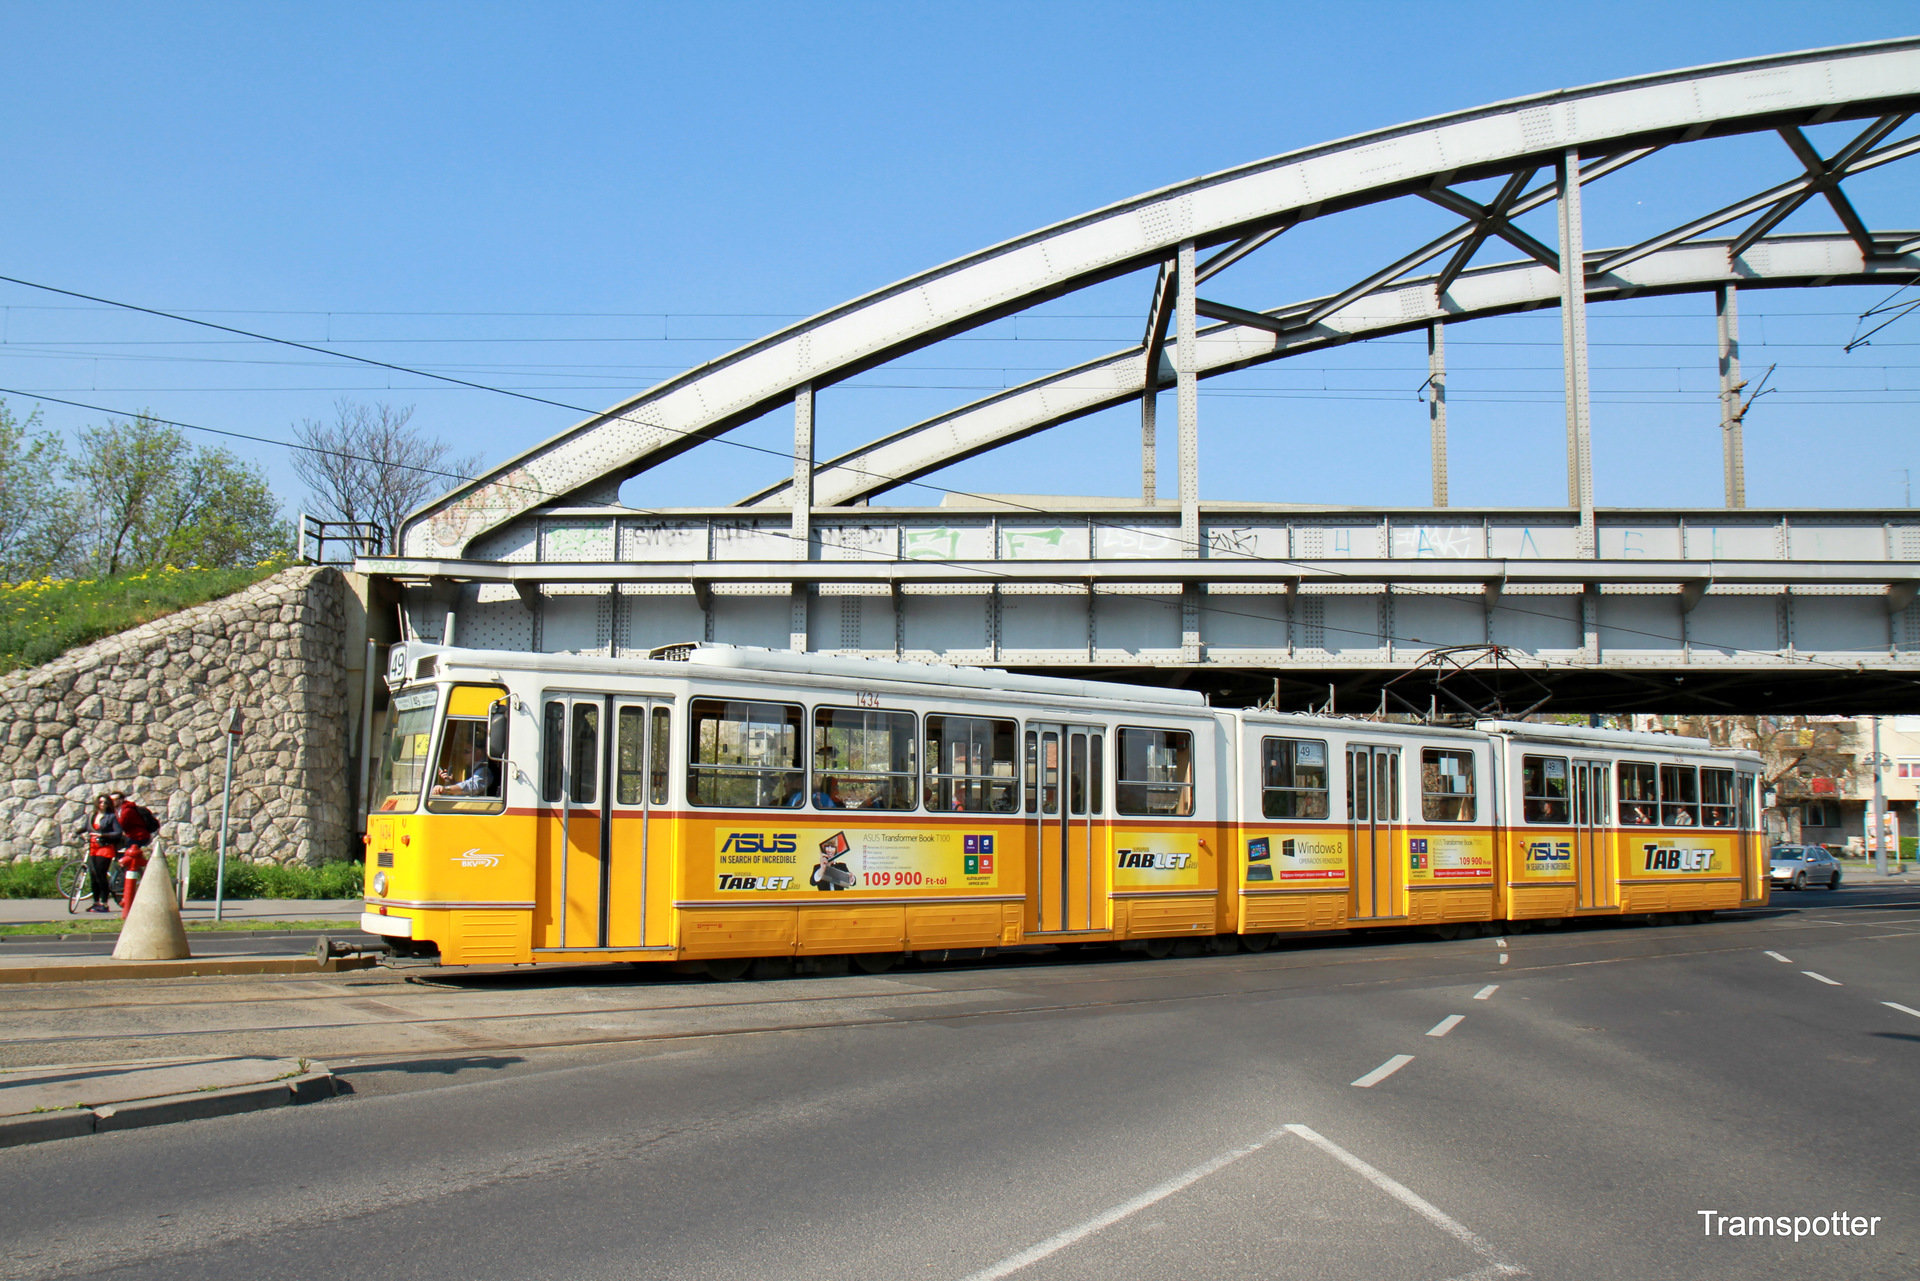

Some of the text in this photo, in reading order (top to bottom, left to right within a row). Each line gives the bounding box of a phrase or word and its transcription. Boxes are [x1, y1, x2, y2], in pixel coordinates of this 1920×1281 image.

[392, 653, 405, 677] 49
[856, 689, 880, 709] 1434
[1300, 746, 1310, 757] 49
[721, 833, 797, 853] ASUS
[863, 833, 951, 842] ASUS Transformer Book T100
[1297, 841, 1343, 854] Windows 8
[1526, 842, 1570, 861] ASUS
[720, 855, 797, 864] IN SEARCH OF INCREDIBLE
[1459, 856, 1471, 865] 109
[1471, 856, 1483, 865] 900
[863, 871, 947, 886] 109 900 Ft-tól
